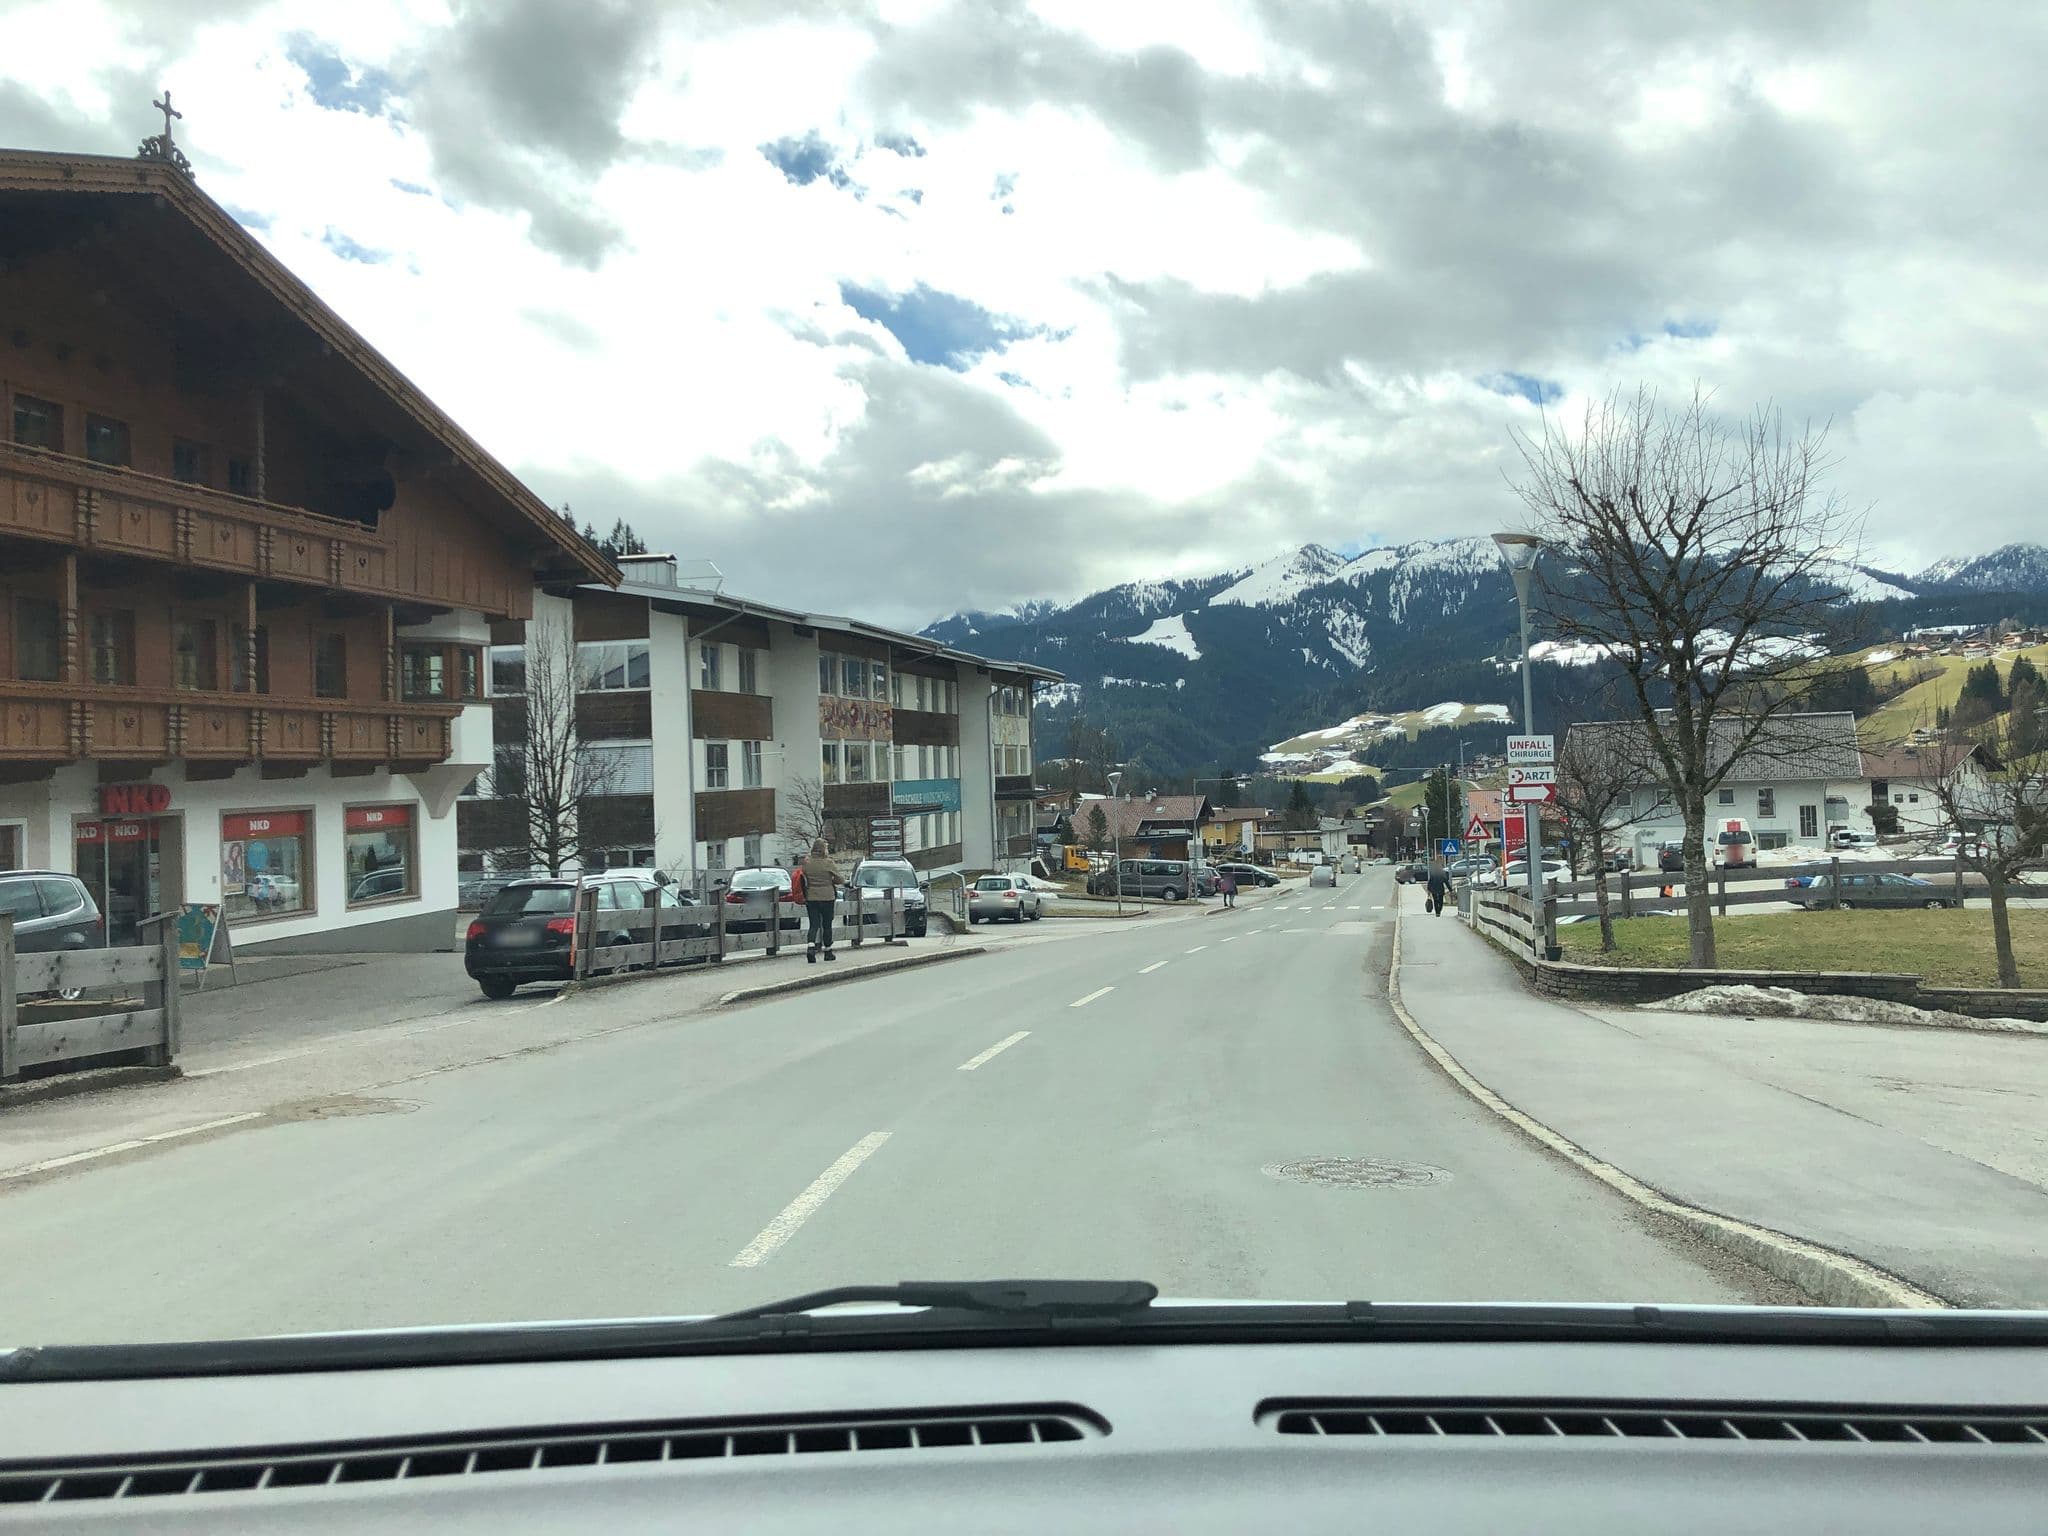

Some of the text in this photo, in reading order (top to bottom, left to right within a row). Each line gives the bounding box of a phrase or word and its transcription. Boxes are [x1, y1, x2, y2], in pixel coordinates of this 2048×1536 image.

[1509, 740, 1552, 750] UNFALL-
[1509, 750, 1553, 758] CHIRURGIE
[1524, 771, 1551, 781] ARZT
[102, 784, 171, 814] NKD
[366, 812, 383, 822] NKD
[115, 824, 140, 837] NKD
[249, 820, 270, 831] NKD
